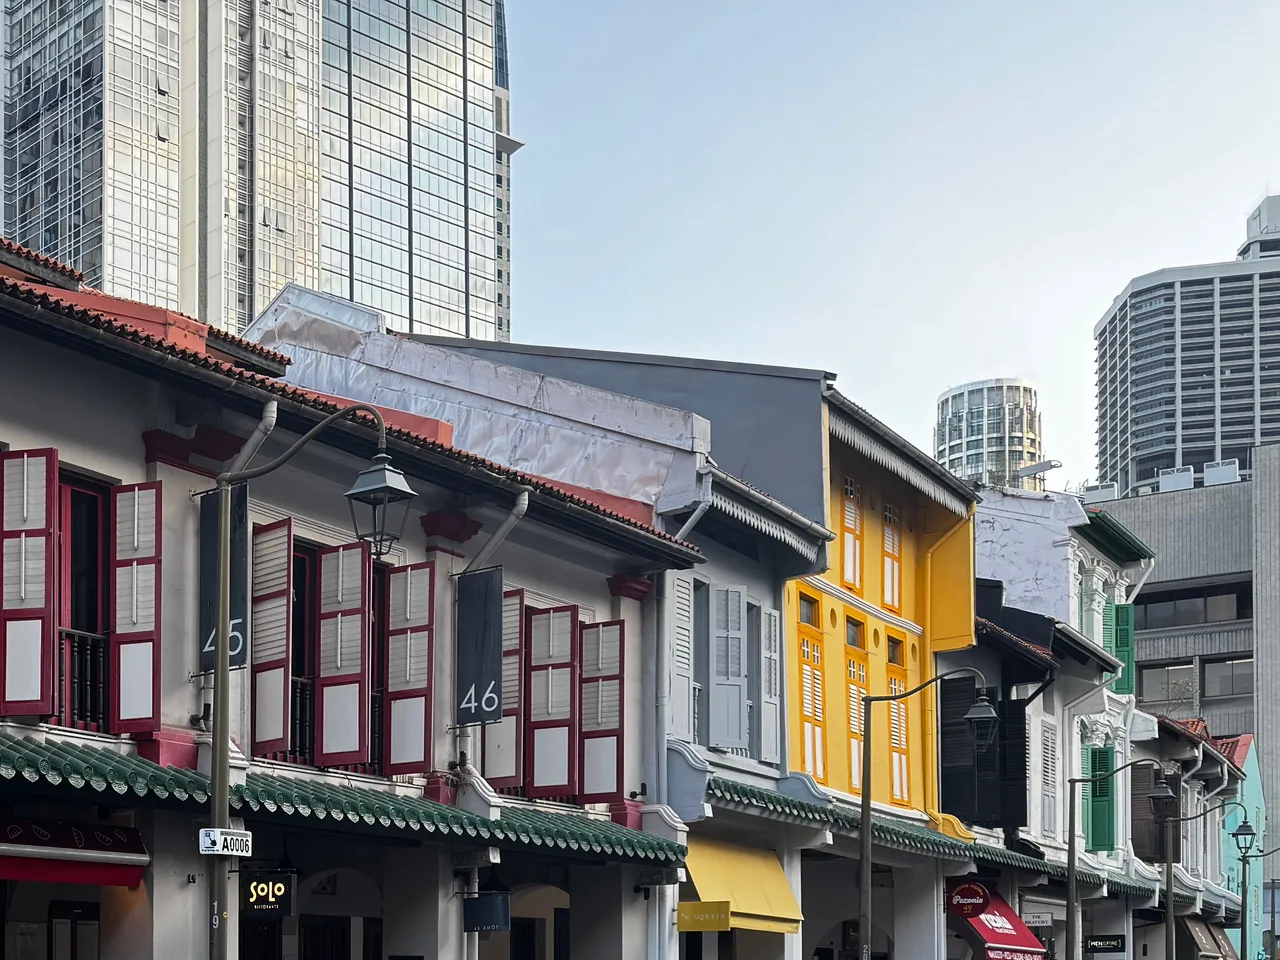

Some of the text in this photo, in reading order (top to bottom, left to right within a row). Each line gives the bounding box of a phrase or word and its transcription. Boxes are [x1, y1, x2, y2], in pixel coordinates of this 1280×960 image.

[460, 680, 499, 714] 46
[221, 836, 250, 853] A0006
[249, 881, 285, 903] SOLO
[952, 895, 984, 905] Pazonia
